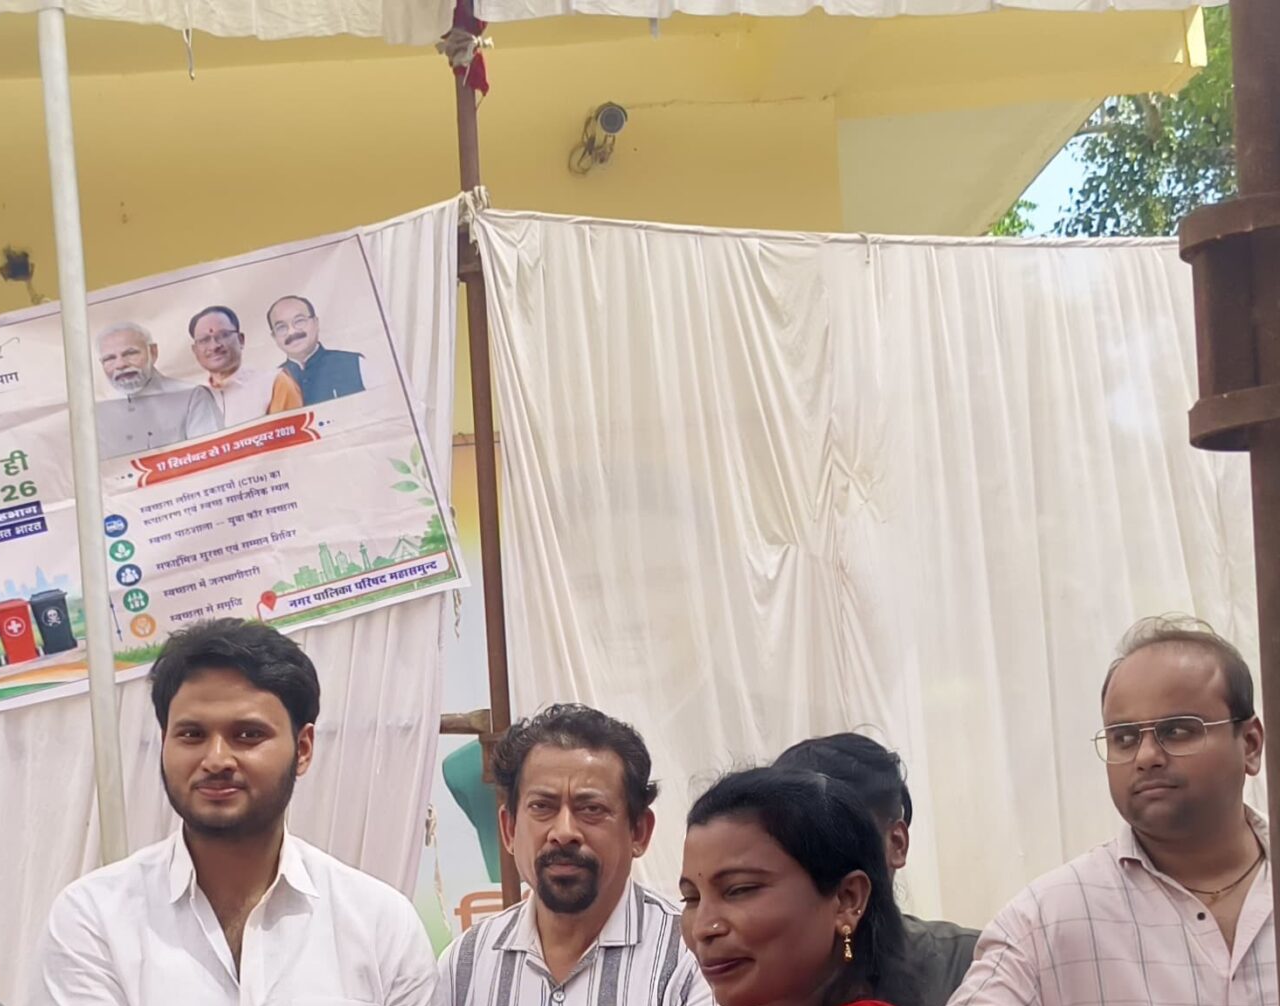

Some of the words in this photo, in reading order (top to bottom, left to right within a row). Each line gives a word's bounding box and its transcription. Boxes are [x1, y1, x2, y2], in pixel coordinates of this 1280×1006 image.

[0, 450, 29, 477] ही
[15, 521, 42, 534] भारत
[288, 595, 311, 609] नगर
[313, 585, 352, 601] पालिका
[354, 574, 387, 591] परिषद
